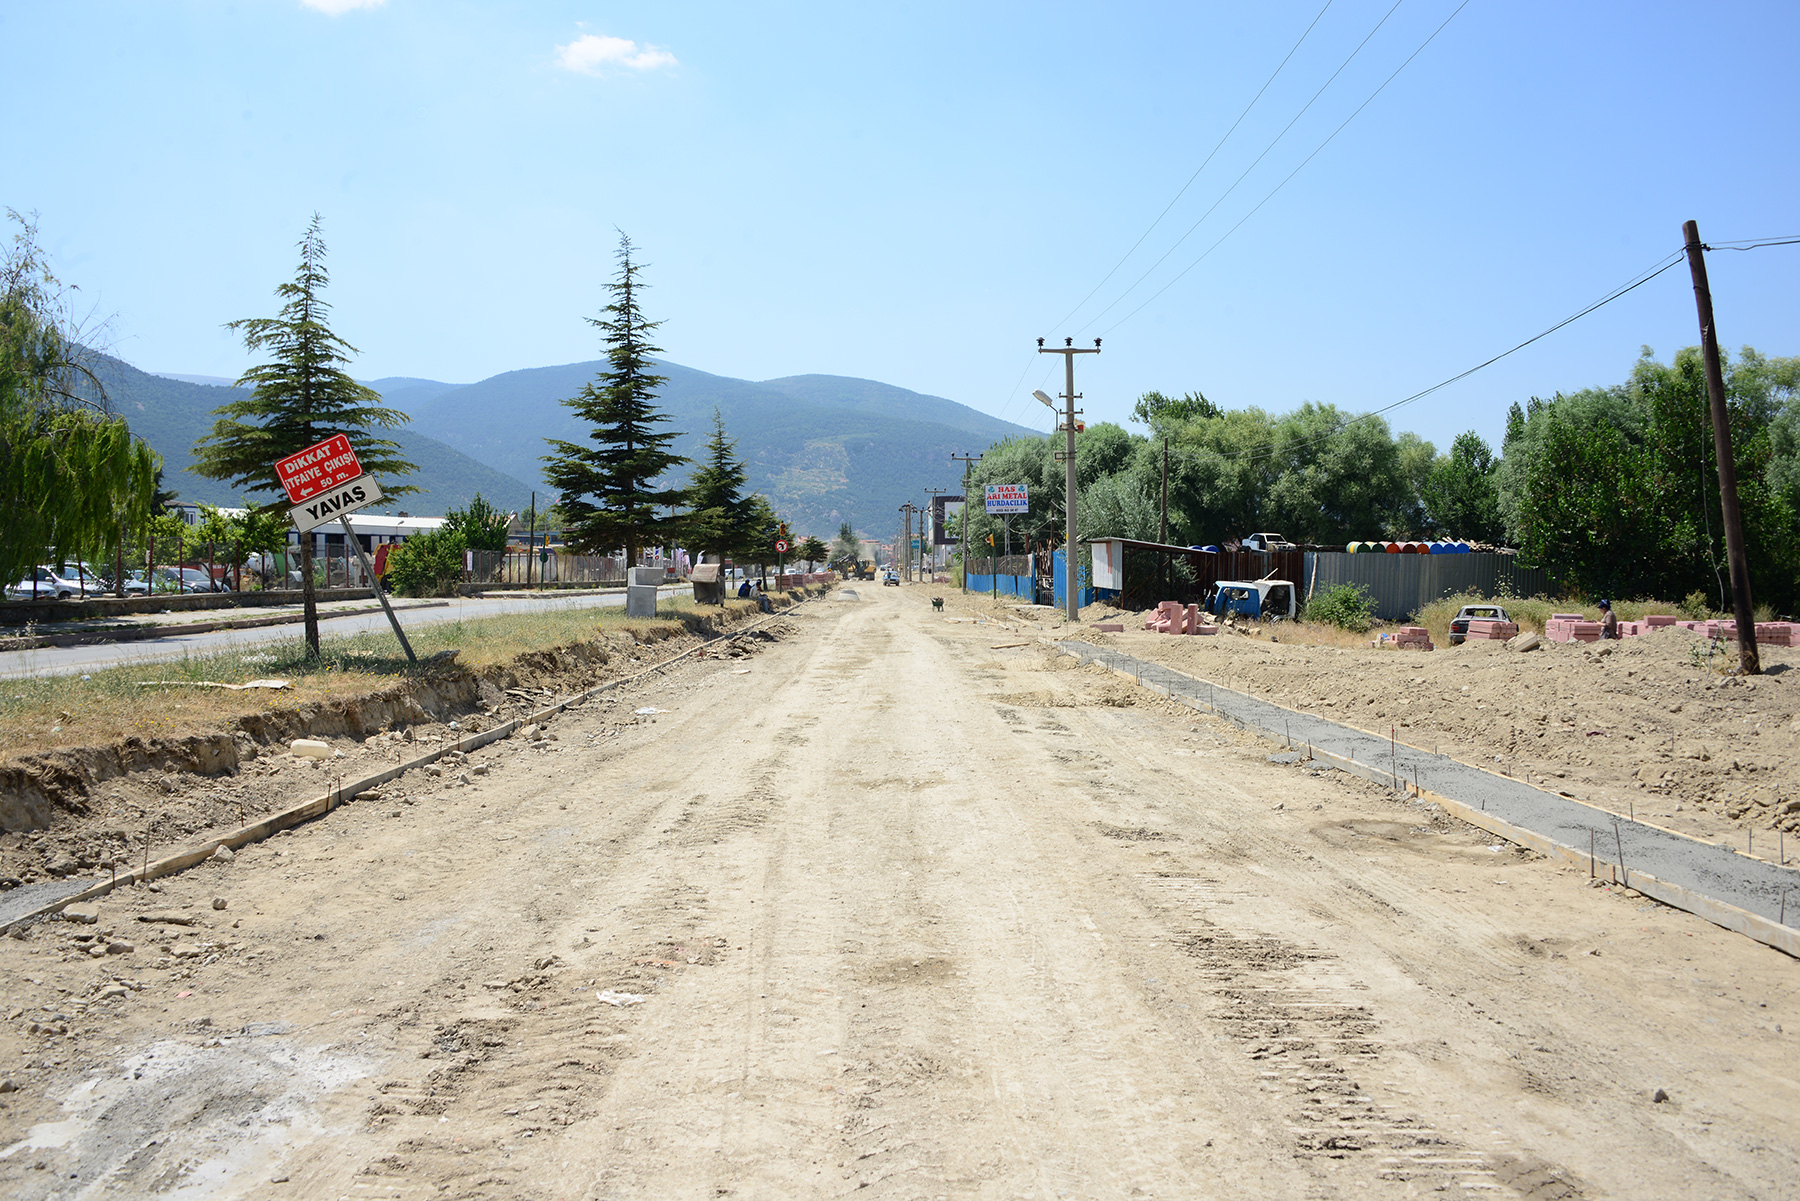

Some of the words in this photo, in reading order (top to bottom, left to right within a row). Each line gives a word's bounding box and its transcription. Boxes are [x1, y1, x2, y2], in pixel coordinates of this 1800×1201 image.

[284, 445, 330, 474] DİKKAT
[336, 441, 343, 451] !
[285, 466, 322, 490] İTFAİYE
[324, 452, 354, 474] ÇIKIŞI
[320, 477, 333, 488] 50
[336, 471, 349, 481] m.
[306, 486, 366, 520] YAVAŞ
